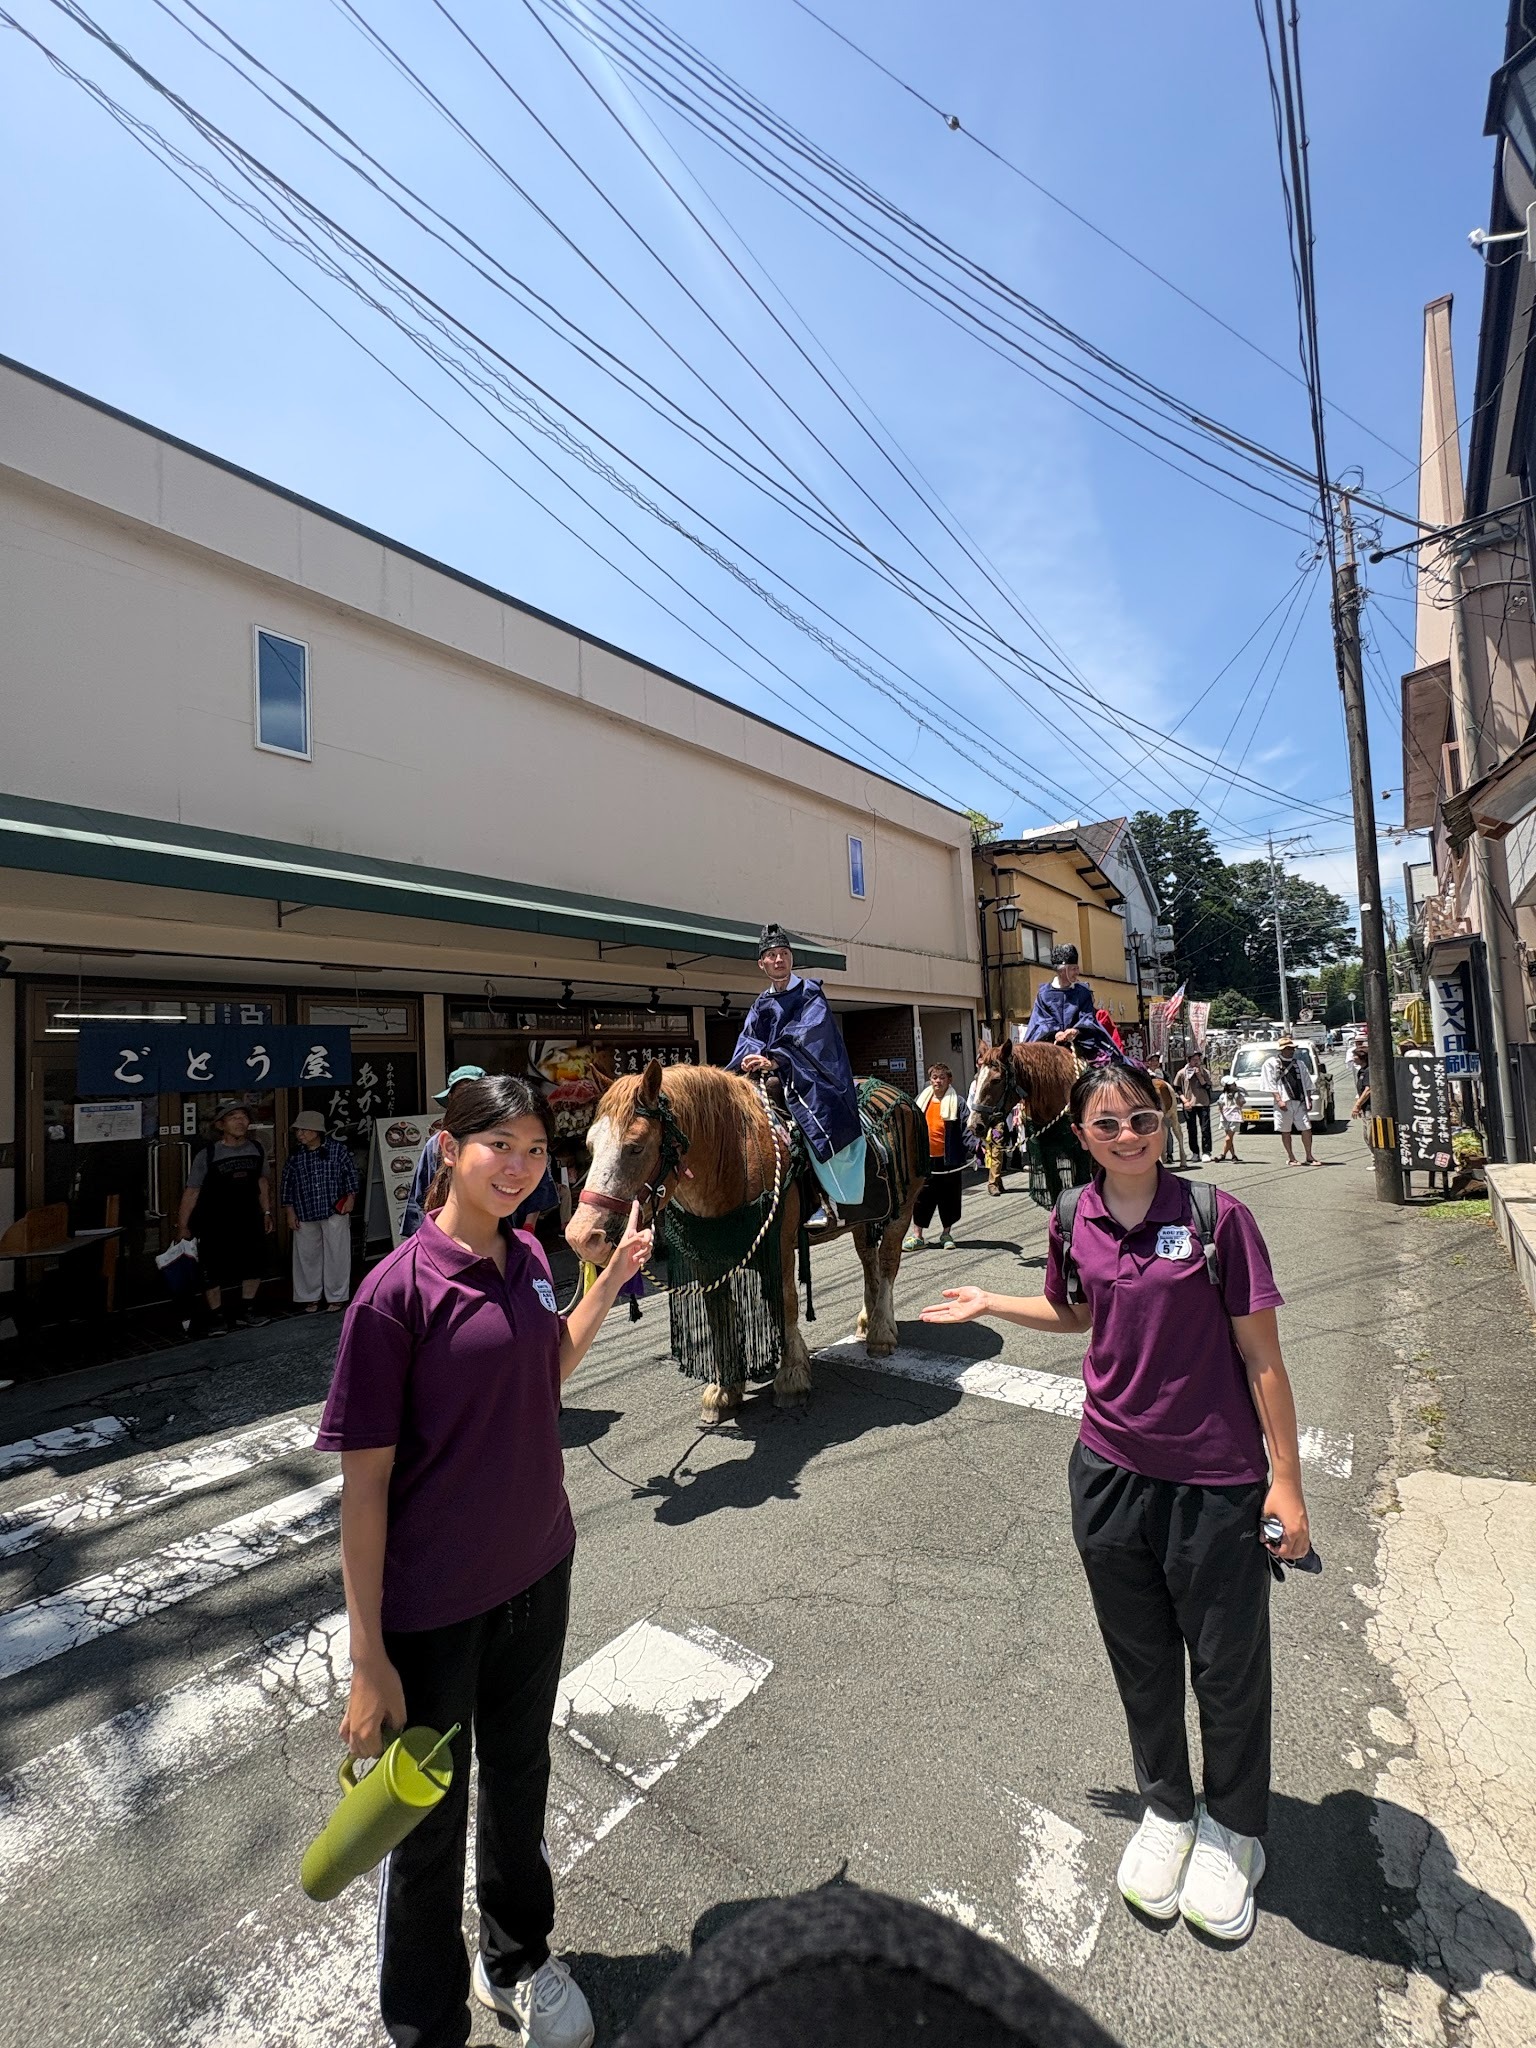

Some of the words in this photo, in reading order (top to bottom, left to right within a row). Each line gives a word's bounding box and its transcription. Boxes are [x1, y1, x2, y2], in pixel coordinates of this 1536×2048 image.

[113, 1045, 333, 1084] ごとう屋
[1127, 1032, 1144, 1062] 焼肉
[356, 1062, 382, 1141] あか牛
[1409, 1063, 1435, 1160] いんさつ屋さん
